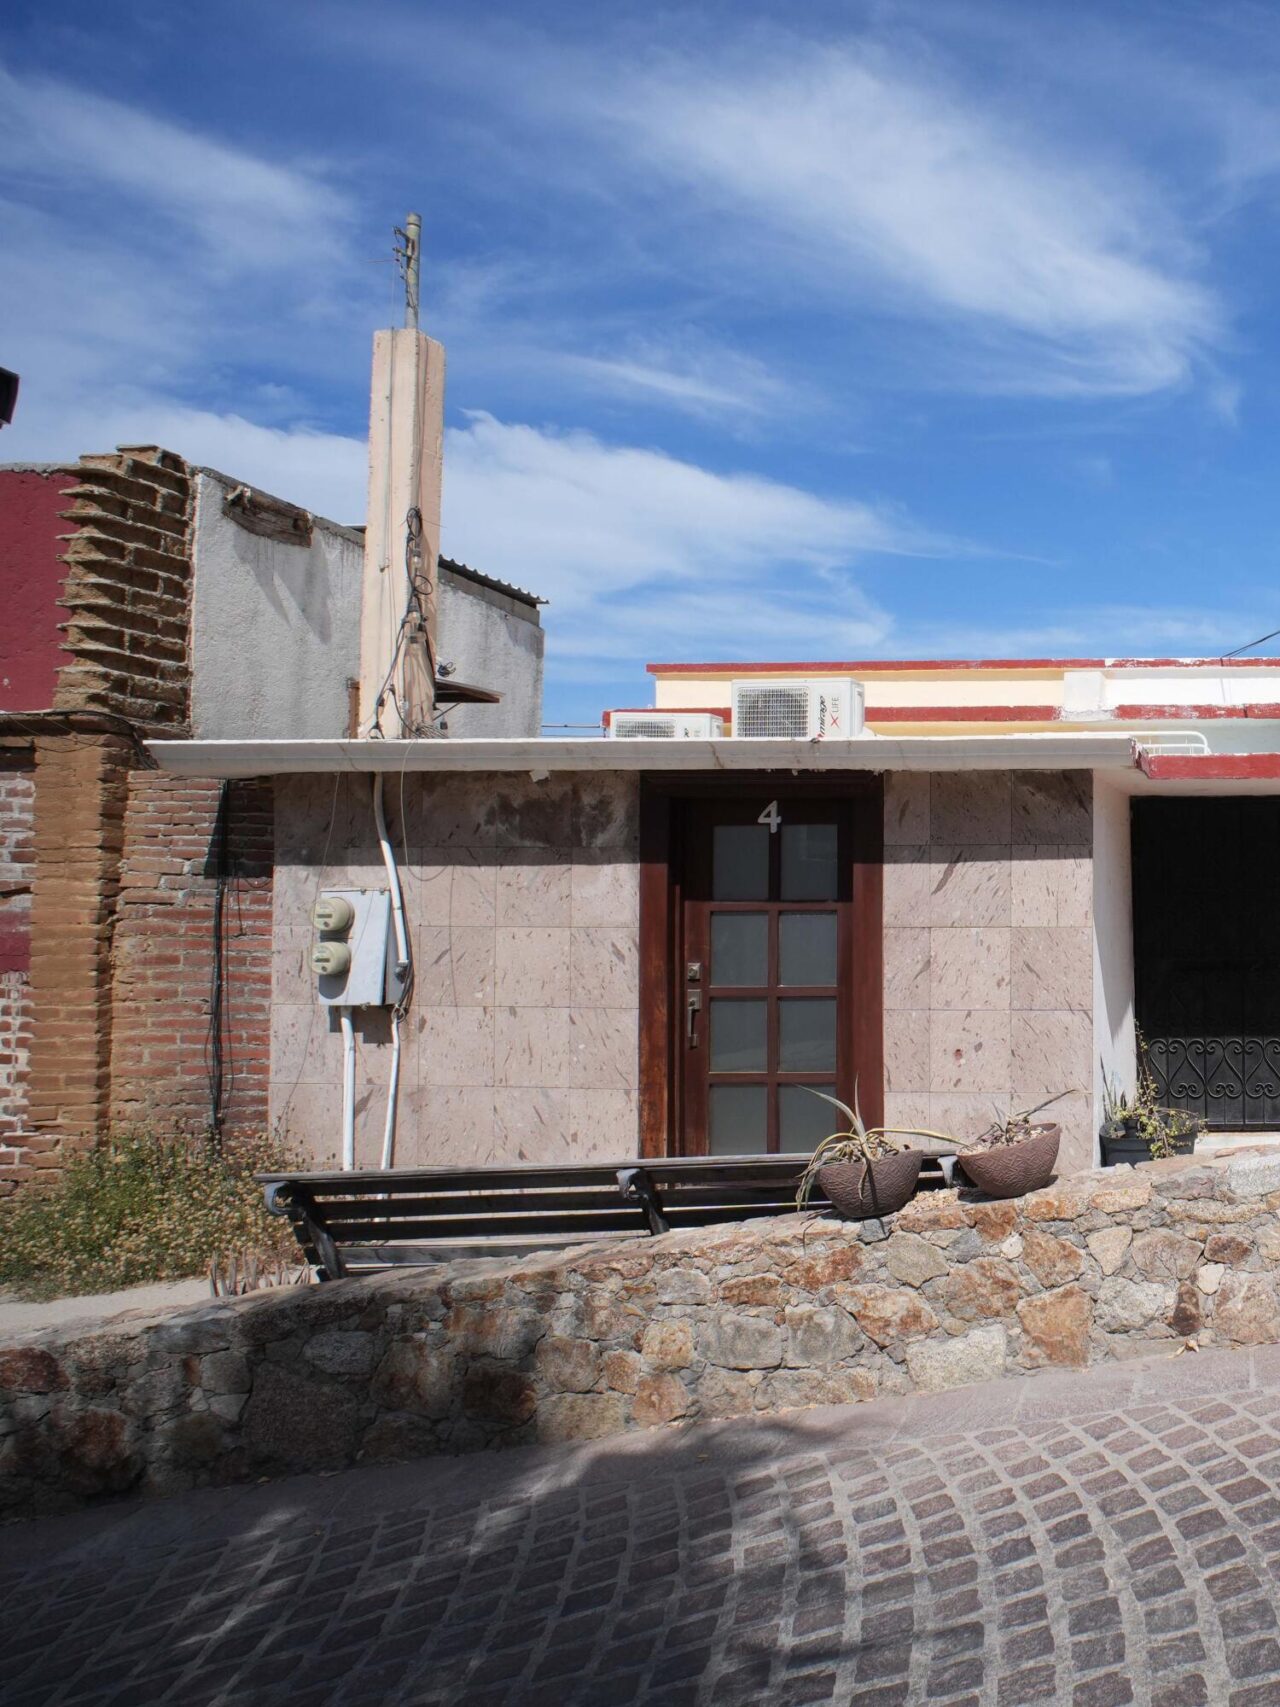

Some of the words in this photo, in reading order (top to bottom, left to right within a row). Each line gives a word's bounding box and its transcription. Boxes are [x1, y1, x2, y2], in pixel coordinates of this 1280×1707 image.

[818, 695, 827, 735] mirage
[831, 697, 840, 712] LIFE
[757, 800, 782, 833] 4
